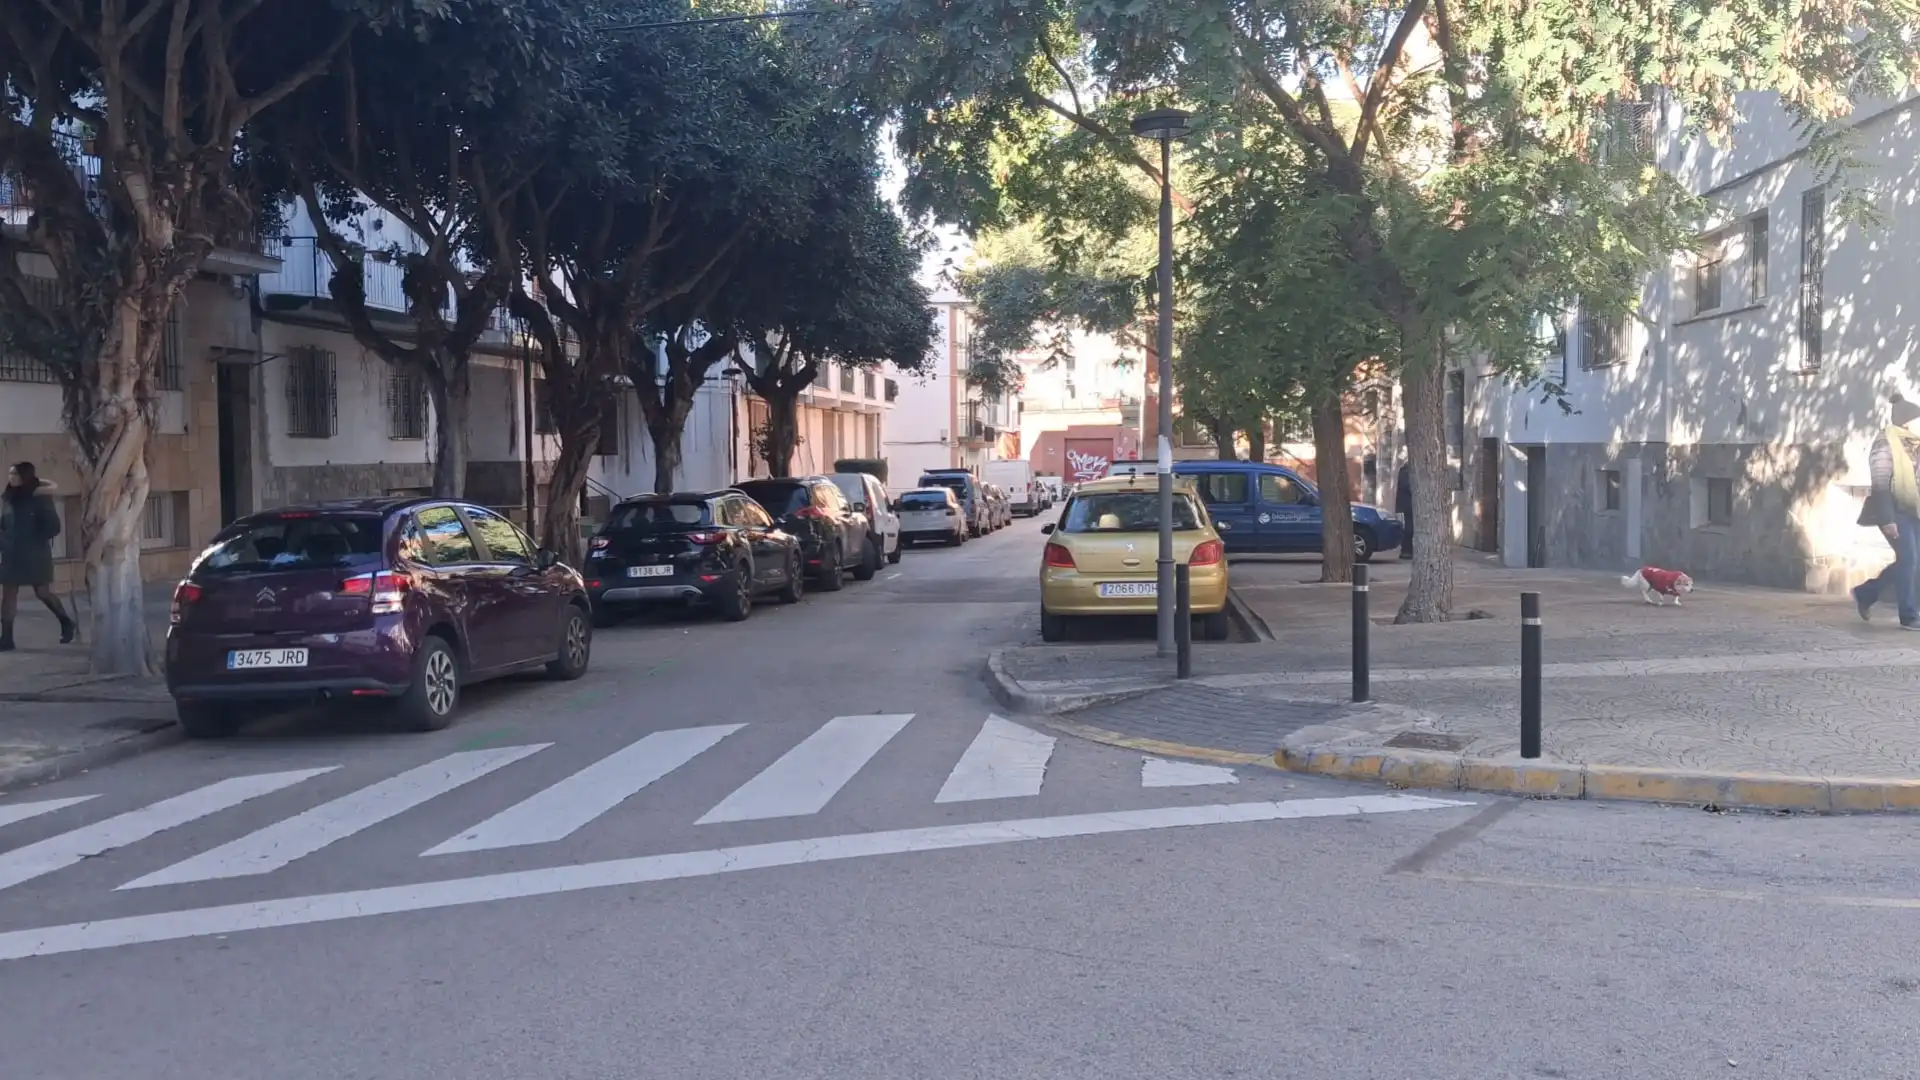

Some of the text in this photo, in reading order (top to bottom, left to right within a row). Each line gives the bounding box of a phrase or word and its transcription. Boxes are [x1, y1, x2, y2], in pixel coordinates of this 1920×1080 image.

[1108, 584, 1134, 594] 2066
[237, 650, 305, 666] 3475 JRD
